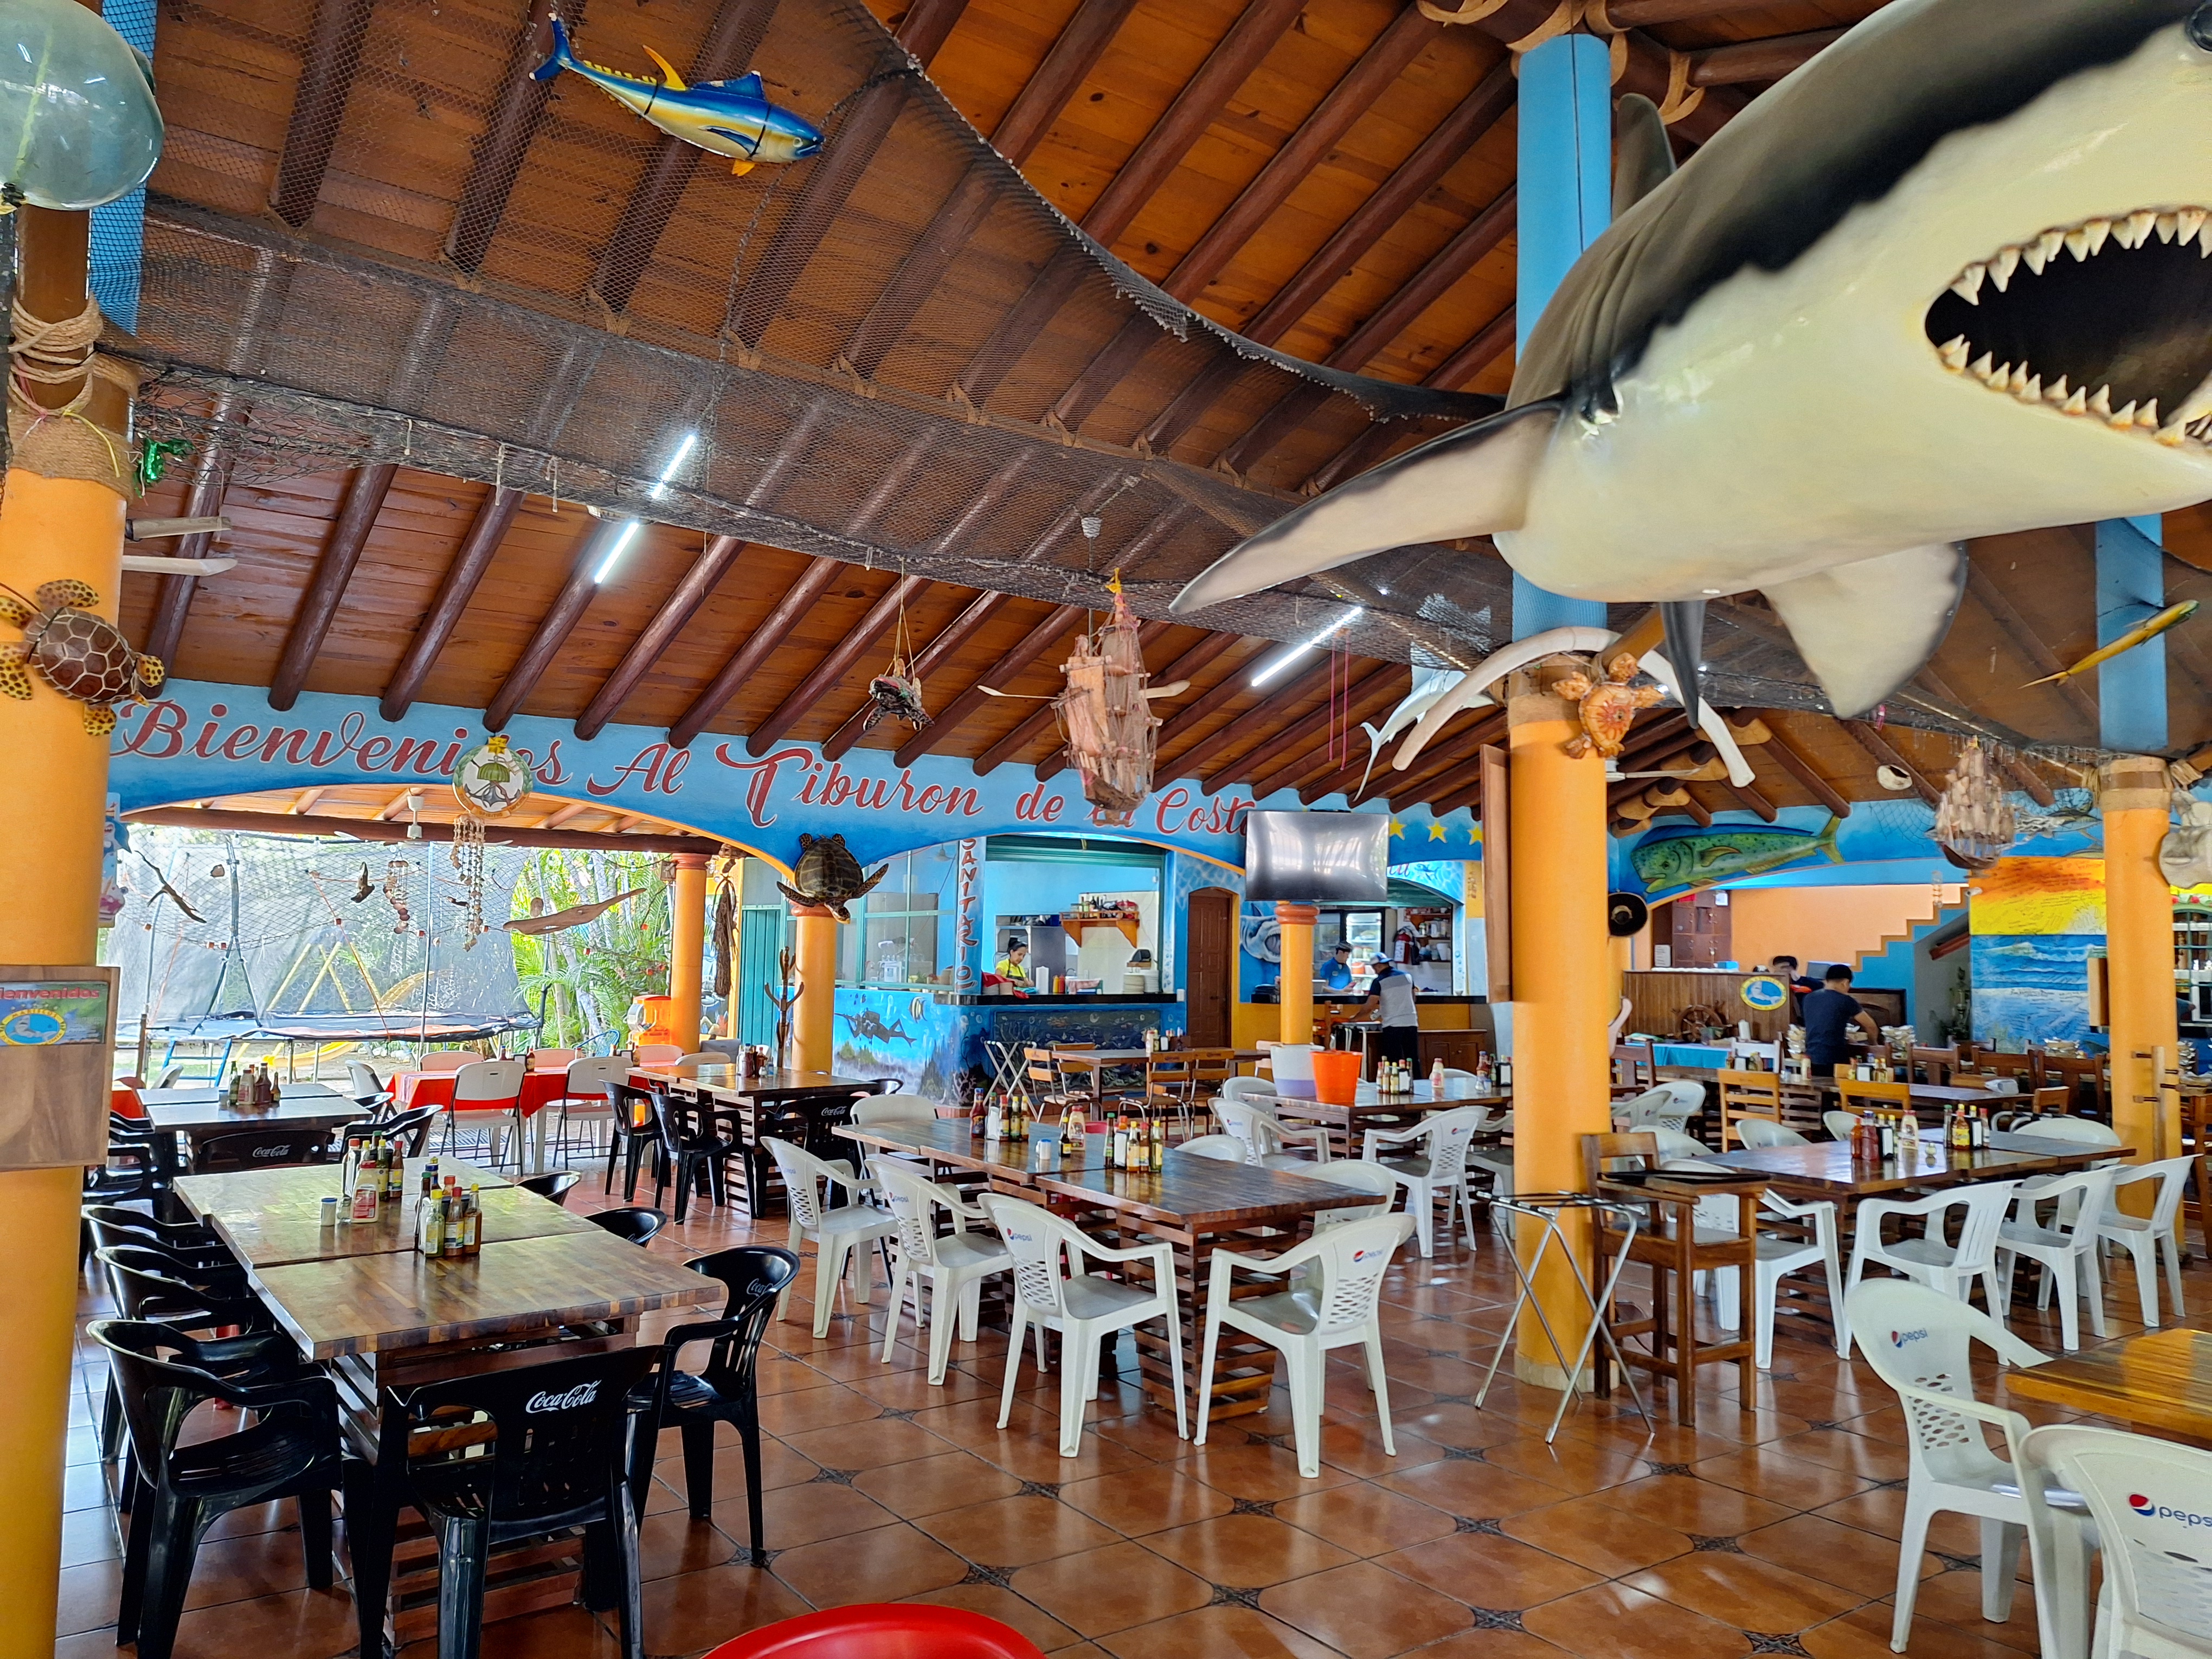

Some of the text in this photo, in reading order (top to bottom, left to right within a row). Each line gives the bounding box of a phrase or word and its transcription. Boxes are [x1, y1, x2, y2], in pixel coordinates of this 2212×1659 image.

[111, 698, 573, 786] Bienvenios
[587, 742, 691, 798] Al
[714, 742, 983, 828] Tiburon
[1015, 783, 1065, 822] de
[957, 839, 978, 980] SANITARIO
[1014, 1232, 1033, 1242] pepsi
[747, 1278, 774, 1297] Coca-C
[1902, 1327, 1928, 1344] pepsi
[526, 1380, 602, 1413] Coca-Cola
